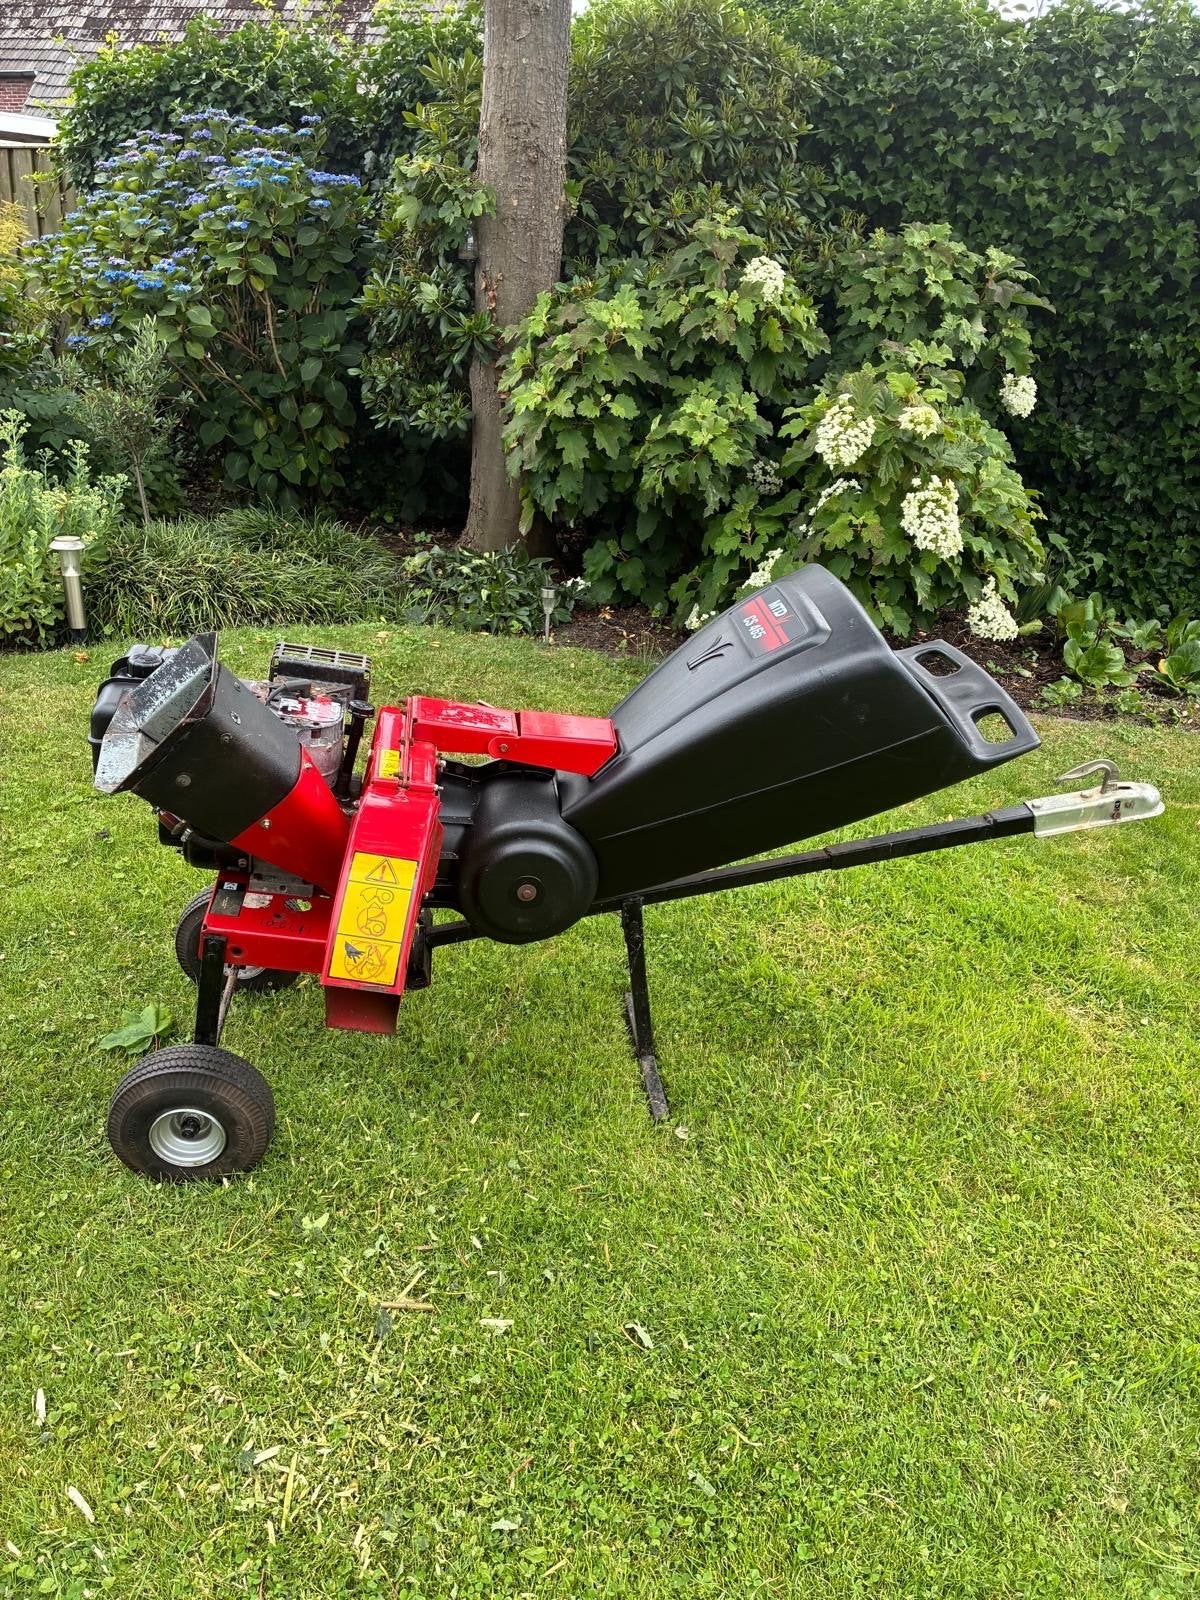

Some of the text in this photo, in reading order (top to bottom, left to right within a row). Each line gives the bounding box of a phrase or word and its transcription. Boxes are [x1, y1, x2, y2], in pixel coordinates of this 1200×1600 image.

[767, 599, 788, 617] MTD
[743, 614, 767, 639] CS 465
